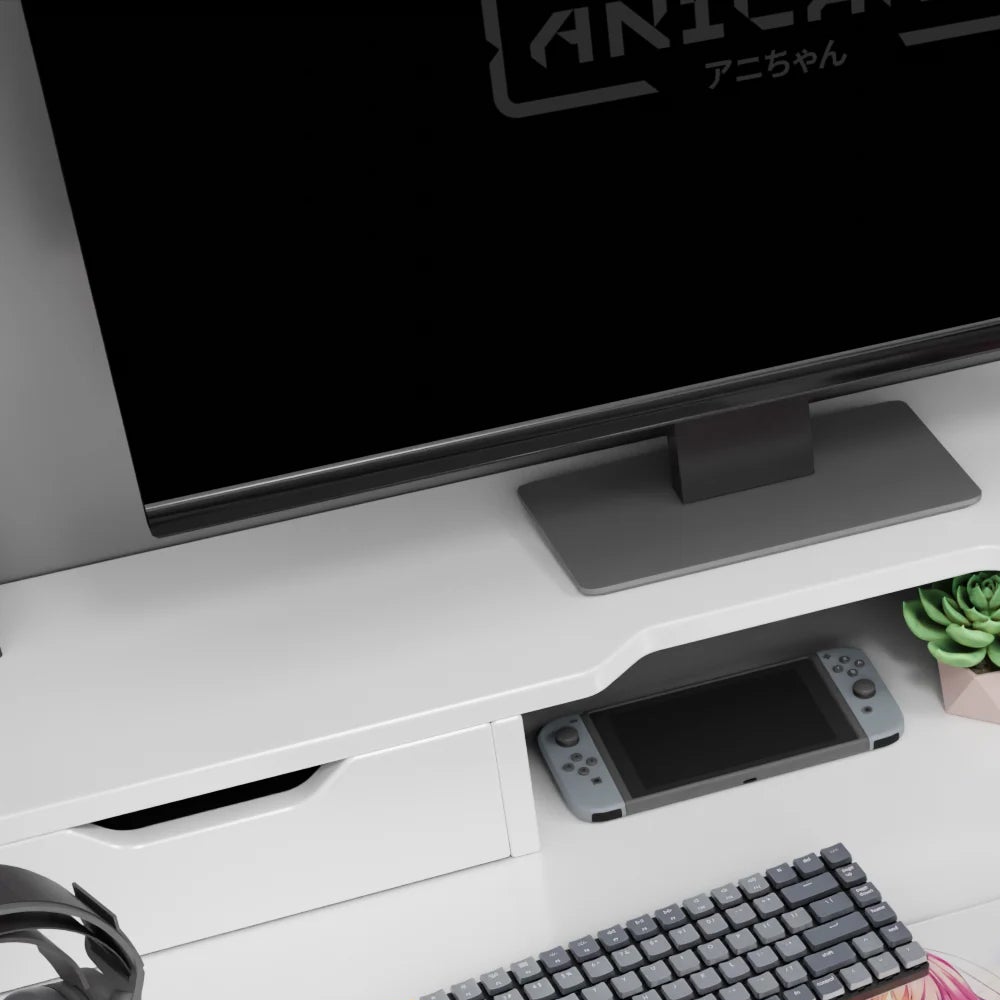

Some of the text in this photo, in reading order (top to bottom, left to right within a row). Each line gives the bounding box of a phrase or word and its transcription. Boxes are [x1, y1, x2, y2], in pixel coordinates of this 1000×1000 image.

[704, 39, 848, 90] アニちゃん
